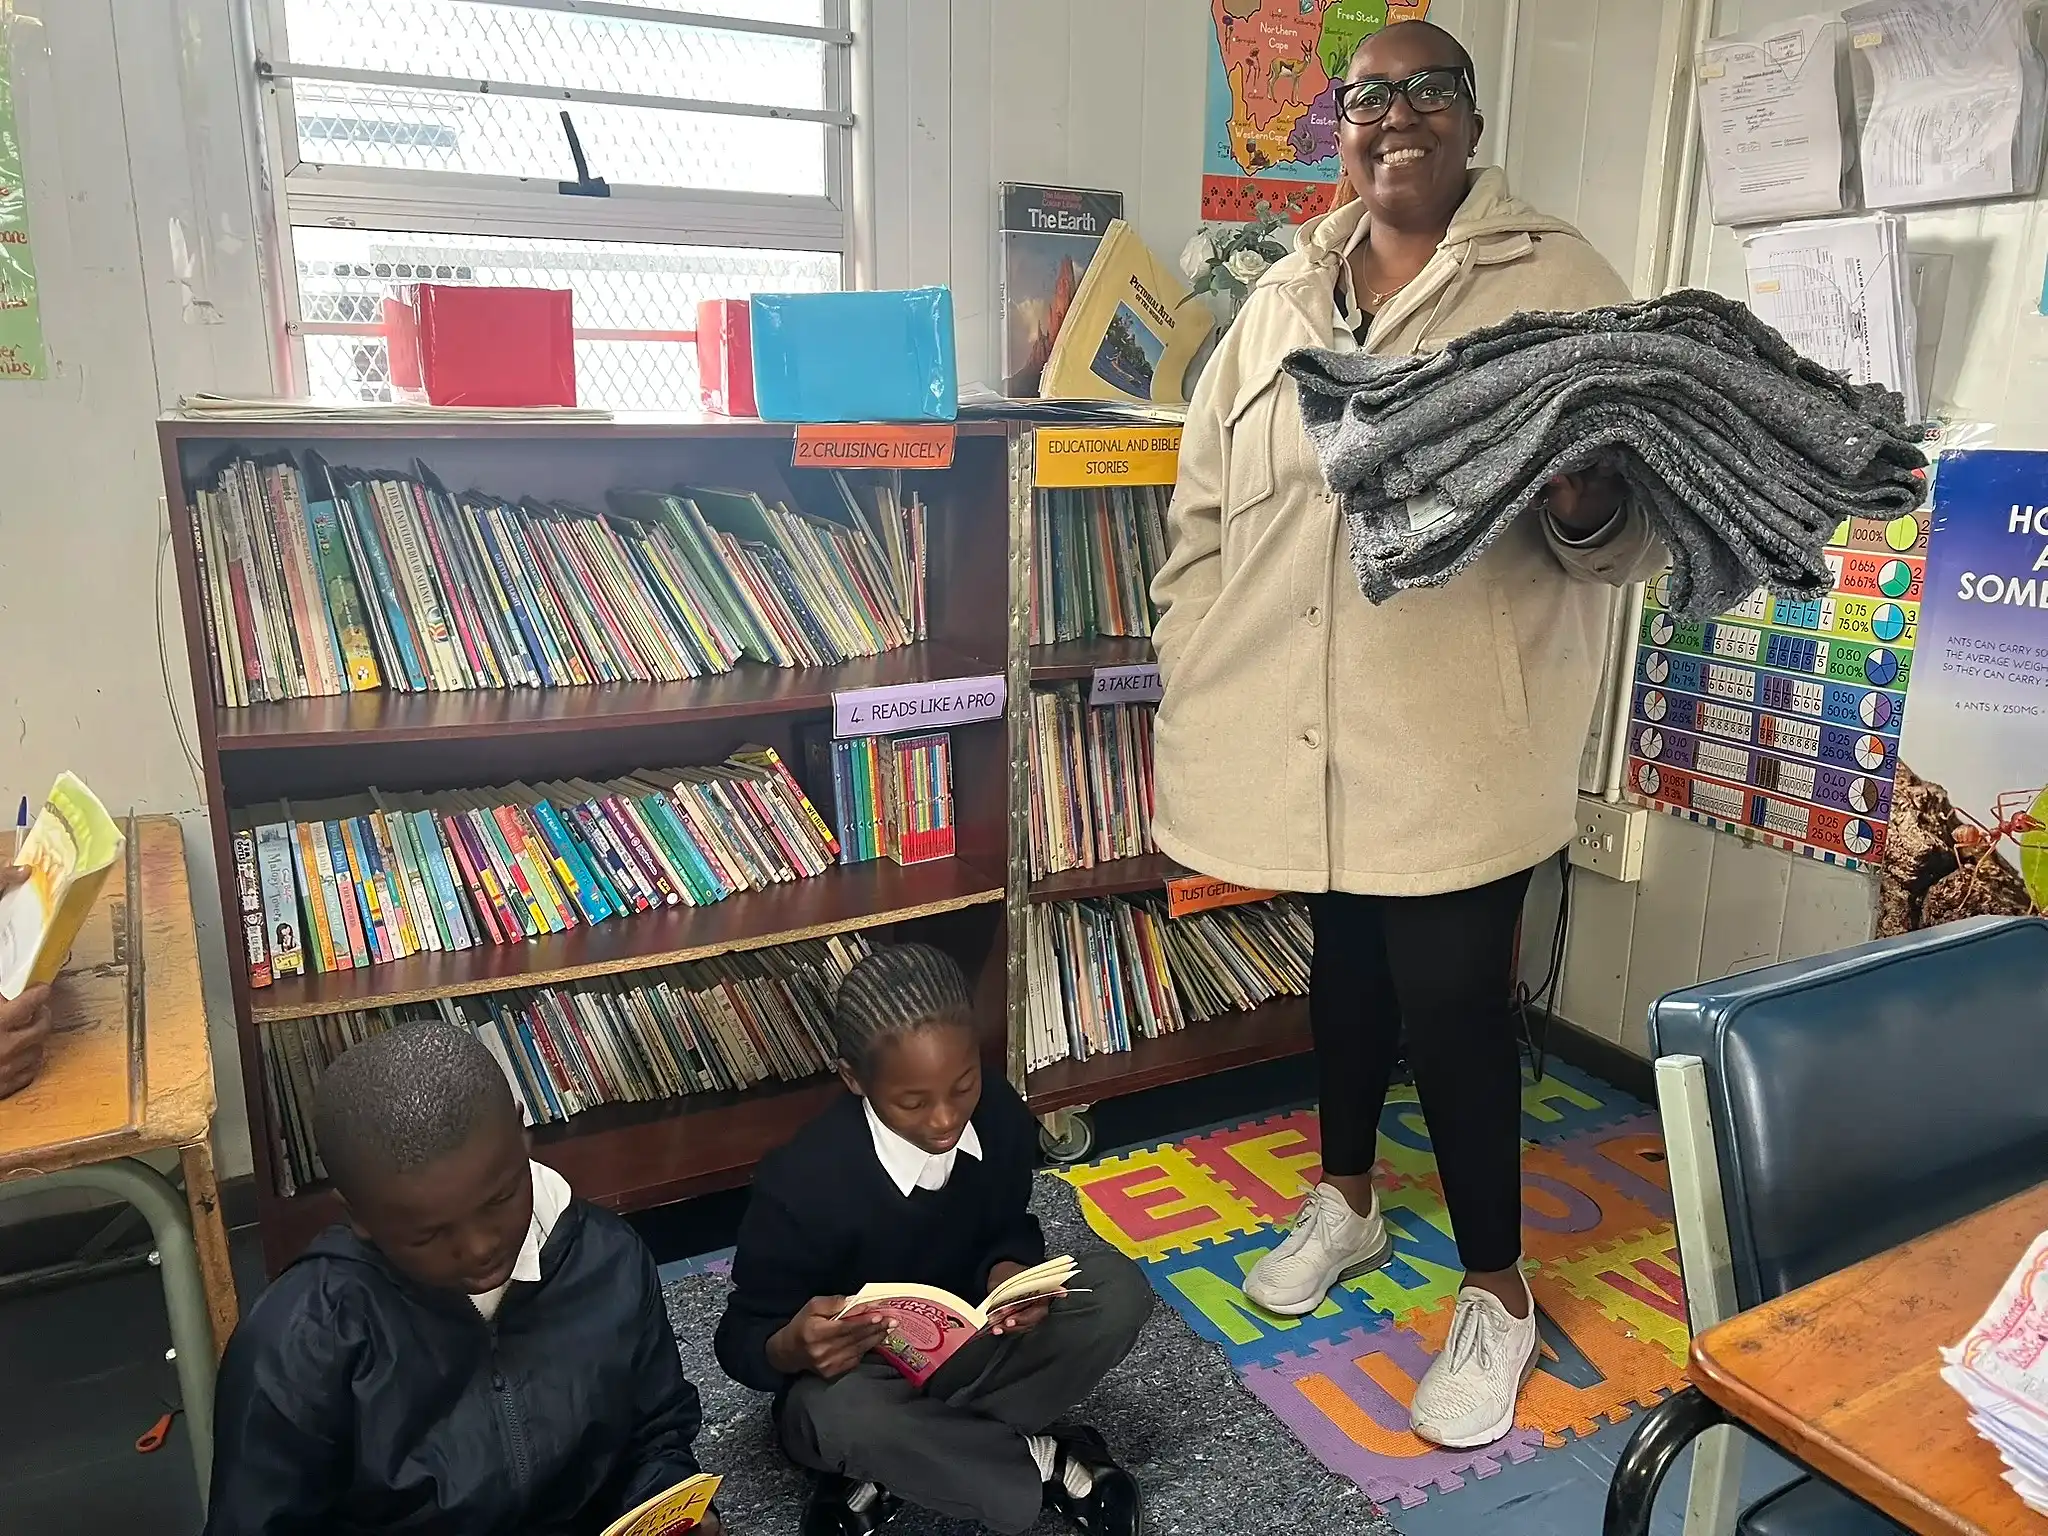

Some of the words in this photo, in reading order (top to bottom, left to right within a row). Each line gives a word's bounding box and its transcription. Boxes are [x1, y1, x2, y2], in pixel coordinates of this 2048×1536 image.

[1337, 7, 1354, 21] Free
[1356, 11, 1380, 24] State
[1260, 22, 1298, 36] Northern
[1269, 38, 1288, 53] Cape
[1310, 114, 1337, 126] Easter
[1235, 127, 1268, 140] Western
[1856, 258, 1864, 288] SILVER
[893, 442, 946, 458] NICELY
[1048, 440, 1124, 453] EDUCATIONAL
[1126, 438, 1150, 452] AND
[1150, 437, 1179, 452] BIBLE
[1085, 460, 1129, 474] STORIES
[387, 486, 400, 509] FIRST
[394, 509, 422, 564] ENCYCLOPEDIA
[412, 564, 422, 574] OF
[414, 574, 433, 605] SCIENCE
[1844, 603, 1867, 616] 0.75
[1838, 618, 1869, 632] 75.0%
[1947, 636, 1972, 648] ANTS
[1974, 639, 1995, 650] CAN
[1998, 643, 2032, 656] CARRY
[1836, 648, 1862, 662] 0.80
[1945, 649, 1964, 660] THE
[1966, 652, 2010, 668] AVERAGE
[1829, 663, 1864, 678] 80.0%
[1956, 664, 1981, 676] THEY
[1983, 668, 2005, 680] CAN
[2008, 672, 2041, 686] CARRY
[1142, 674, 1155, 689] IT
[850, 707, 864, 724] 4.
[872, 702, 917, 721] READS
[920, 697, 950, 714] LIKE
[952, 697, 965, 711] A
[967, 693, 996, 709] PRO
[1827, 705, 1858, 720] 50.0%
[1964, 702, 1991, 712] ANTS
[2002, 704, 2038, 716] 250MG
[1828, 732, 1850, 746] 0.25
[1822, 746, 1854, 762] 25.0%
[1815, 787, 1848, 804] 40.0%
[1817, 815, 1839, 829] 0.25
[507, 831, 522, 850] Dahl
[1812, 829, 1840, 844] 25.0%
[331, 848, 347, 871] Dahl
[264, 853, 285, 889] Malory
[1180, 887, 1206, 902] JUST
[269, 893, 284, 922] Towers
[1081, 1163, 1231, 1243] E
